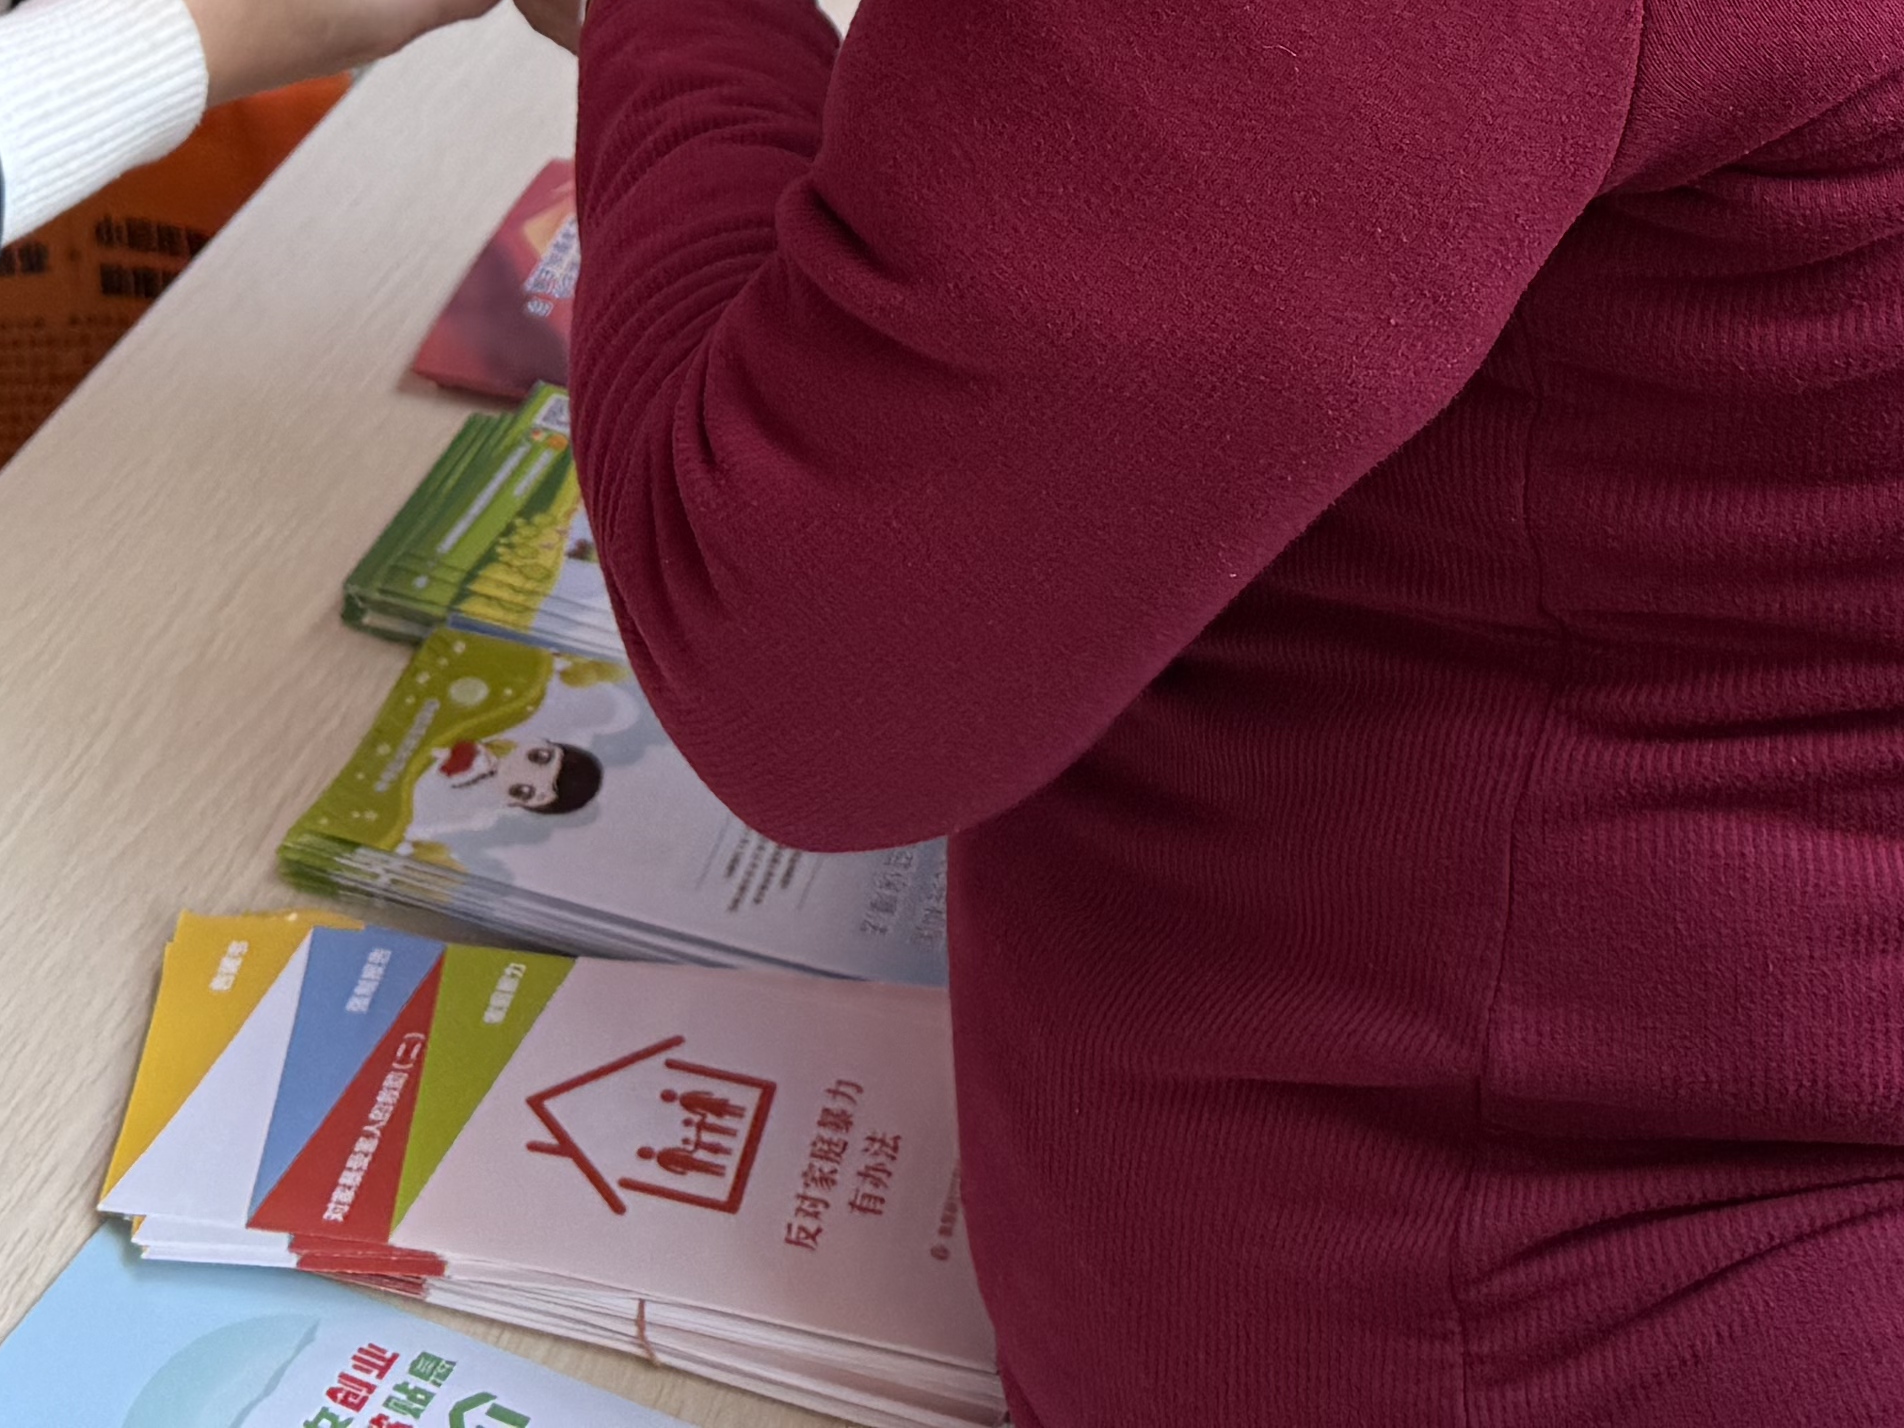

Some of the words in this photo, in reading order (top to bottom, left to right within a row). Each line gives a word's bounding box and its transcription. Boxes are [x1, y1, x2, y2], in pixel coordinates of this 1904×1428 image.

[784, 1078, 865, 1252] 反对家庭暴力
[848, 1130, 902, 1217] 有办法
